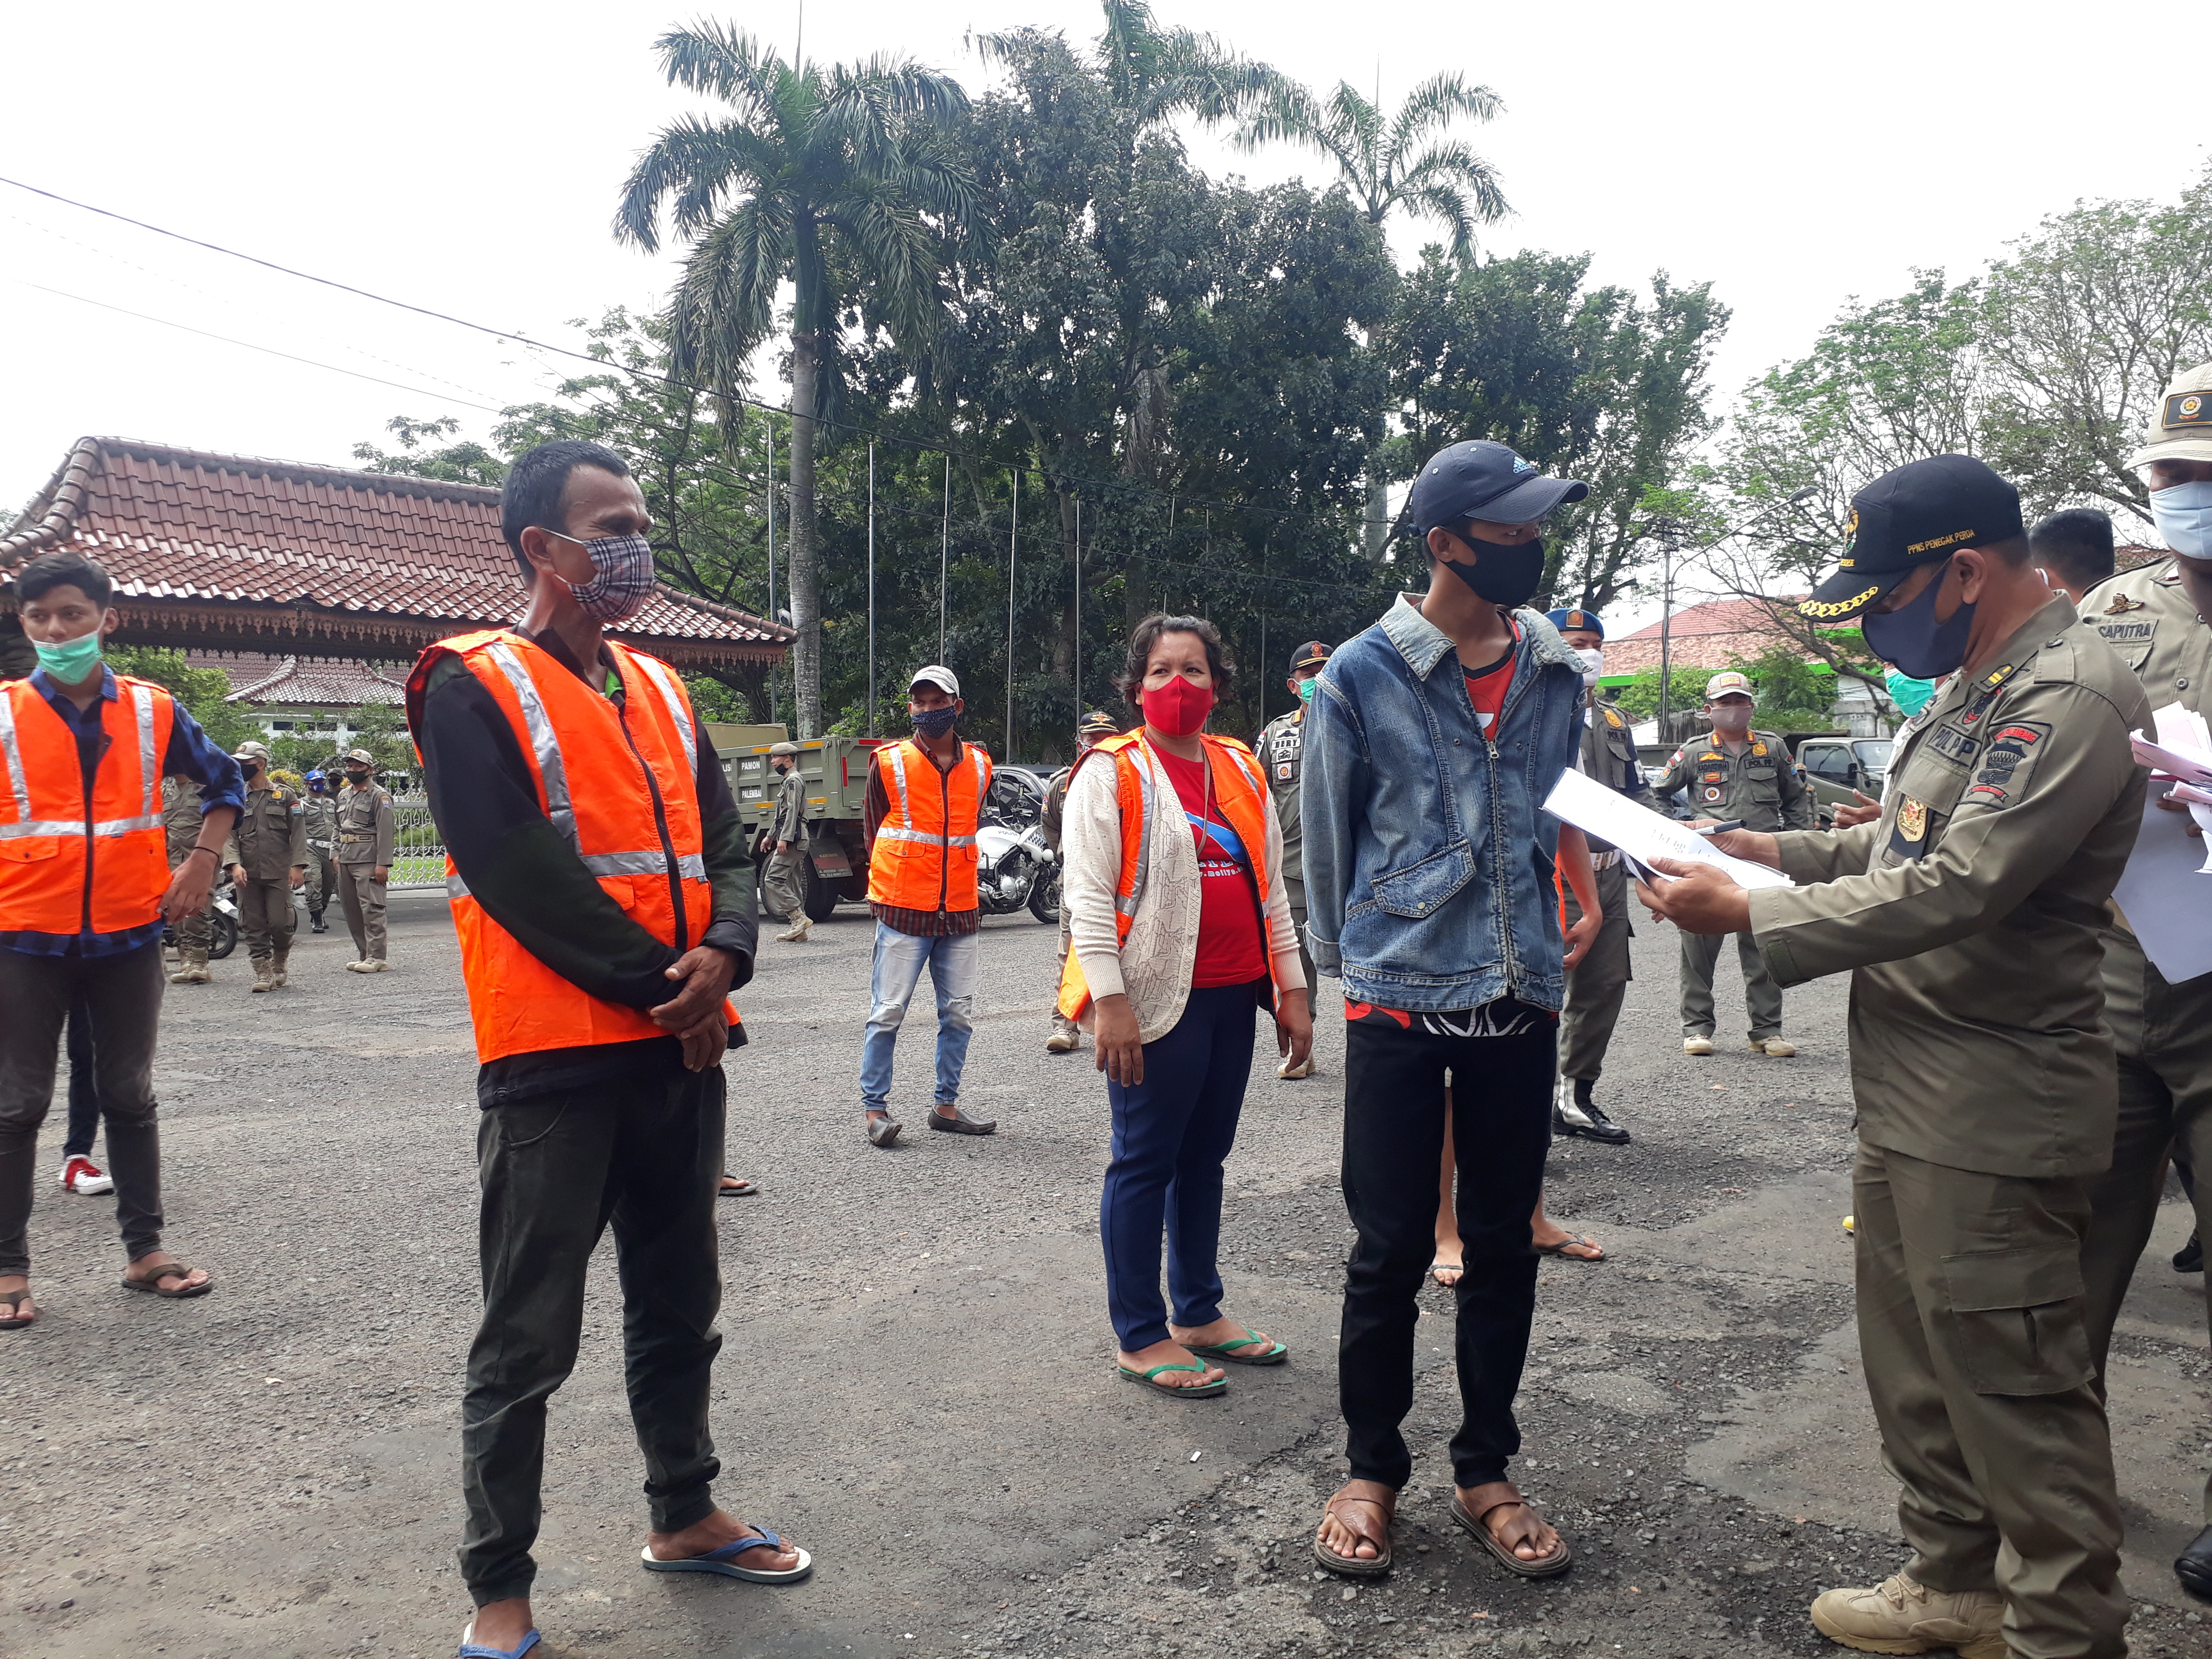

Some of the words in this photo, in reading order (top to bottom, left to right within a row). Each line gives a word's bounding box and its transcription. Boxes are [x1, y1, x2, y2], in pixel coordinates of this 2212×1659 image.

[1907, 542, 1927, 555] PPNS
[1925, 534, 1955, 550] PENEGAK
[2098, 623, 2151, 639] SAPUTRA
[1931, 728, 1954, 750] POL
[741, 761, 760, 771] PAMON
